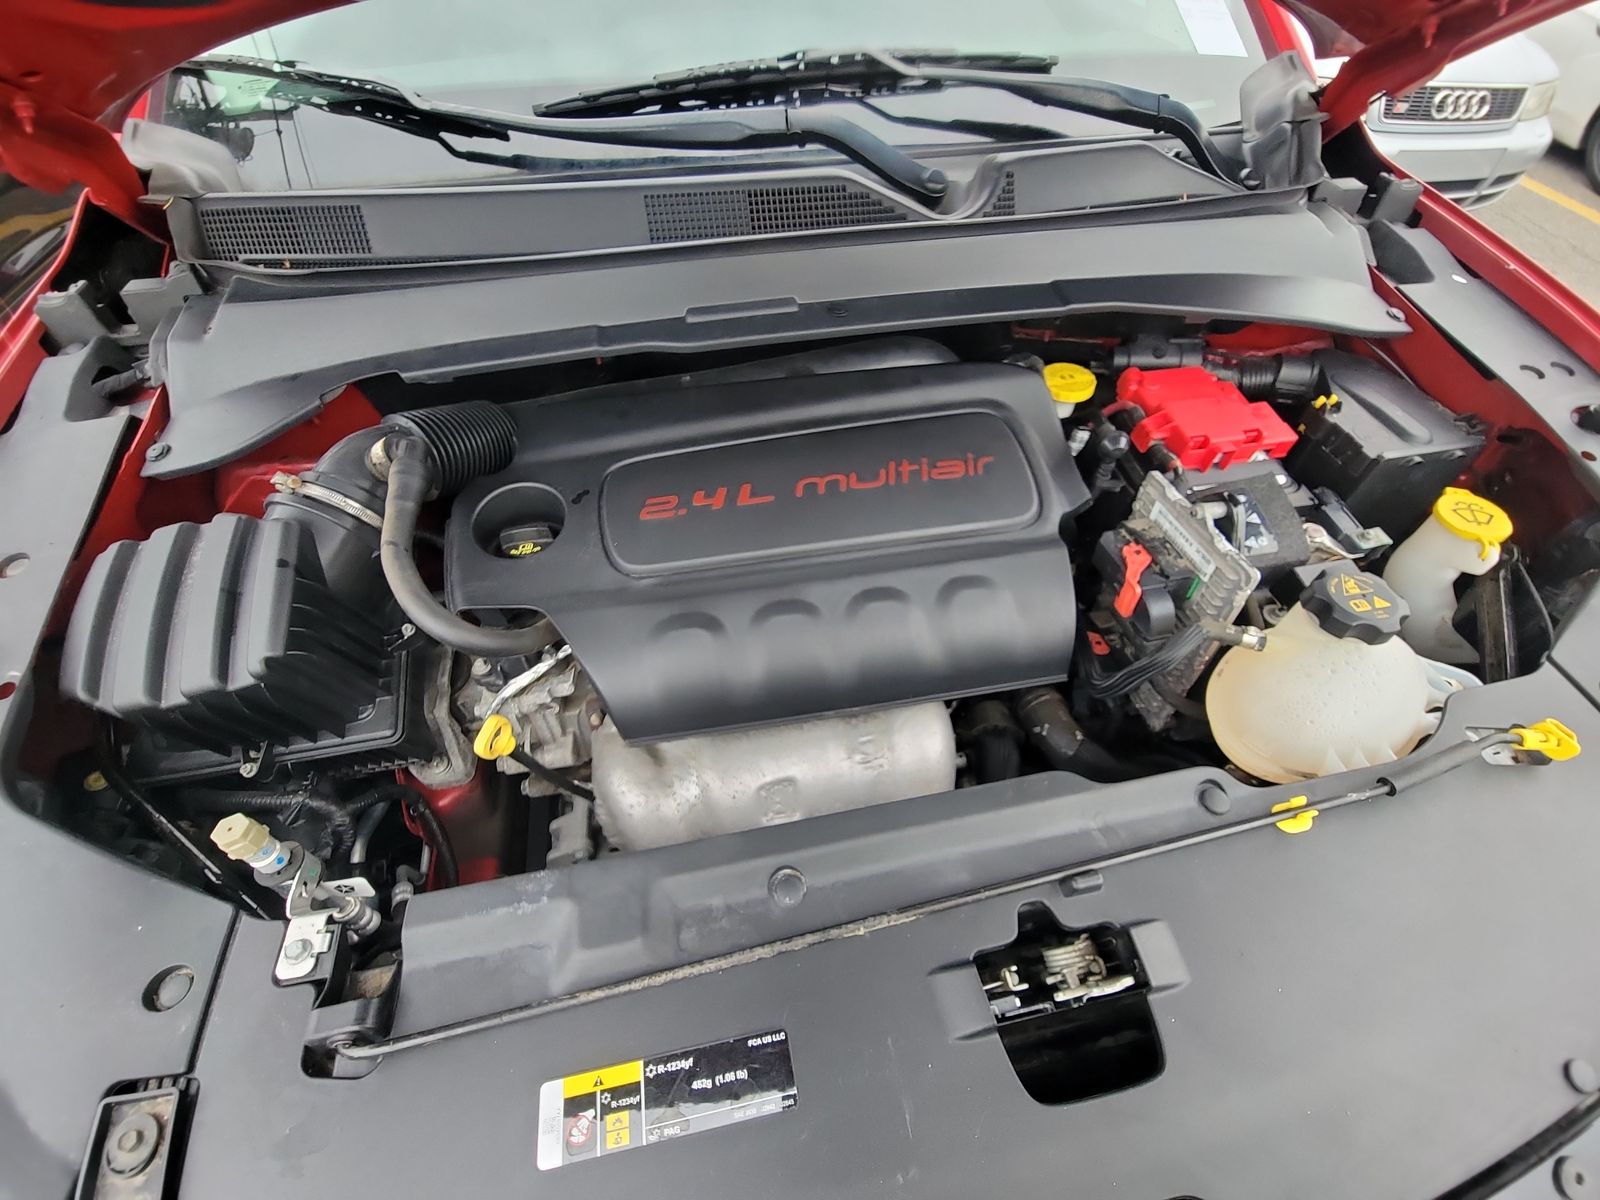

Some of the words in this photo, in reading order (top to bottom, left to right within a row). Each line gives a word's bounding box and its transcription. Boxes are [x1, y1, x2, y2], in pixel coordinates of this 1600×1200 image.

[795, 453, 994, 499] multiair
[772, 1032, 786, 1042] LLC
[657, 1057, 694, 1075] R-1234yf
[663, 1125, 681, 1137] PAG
